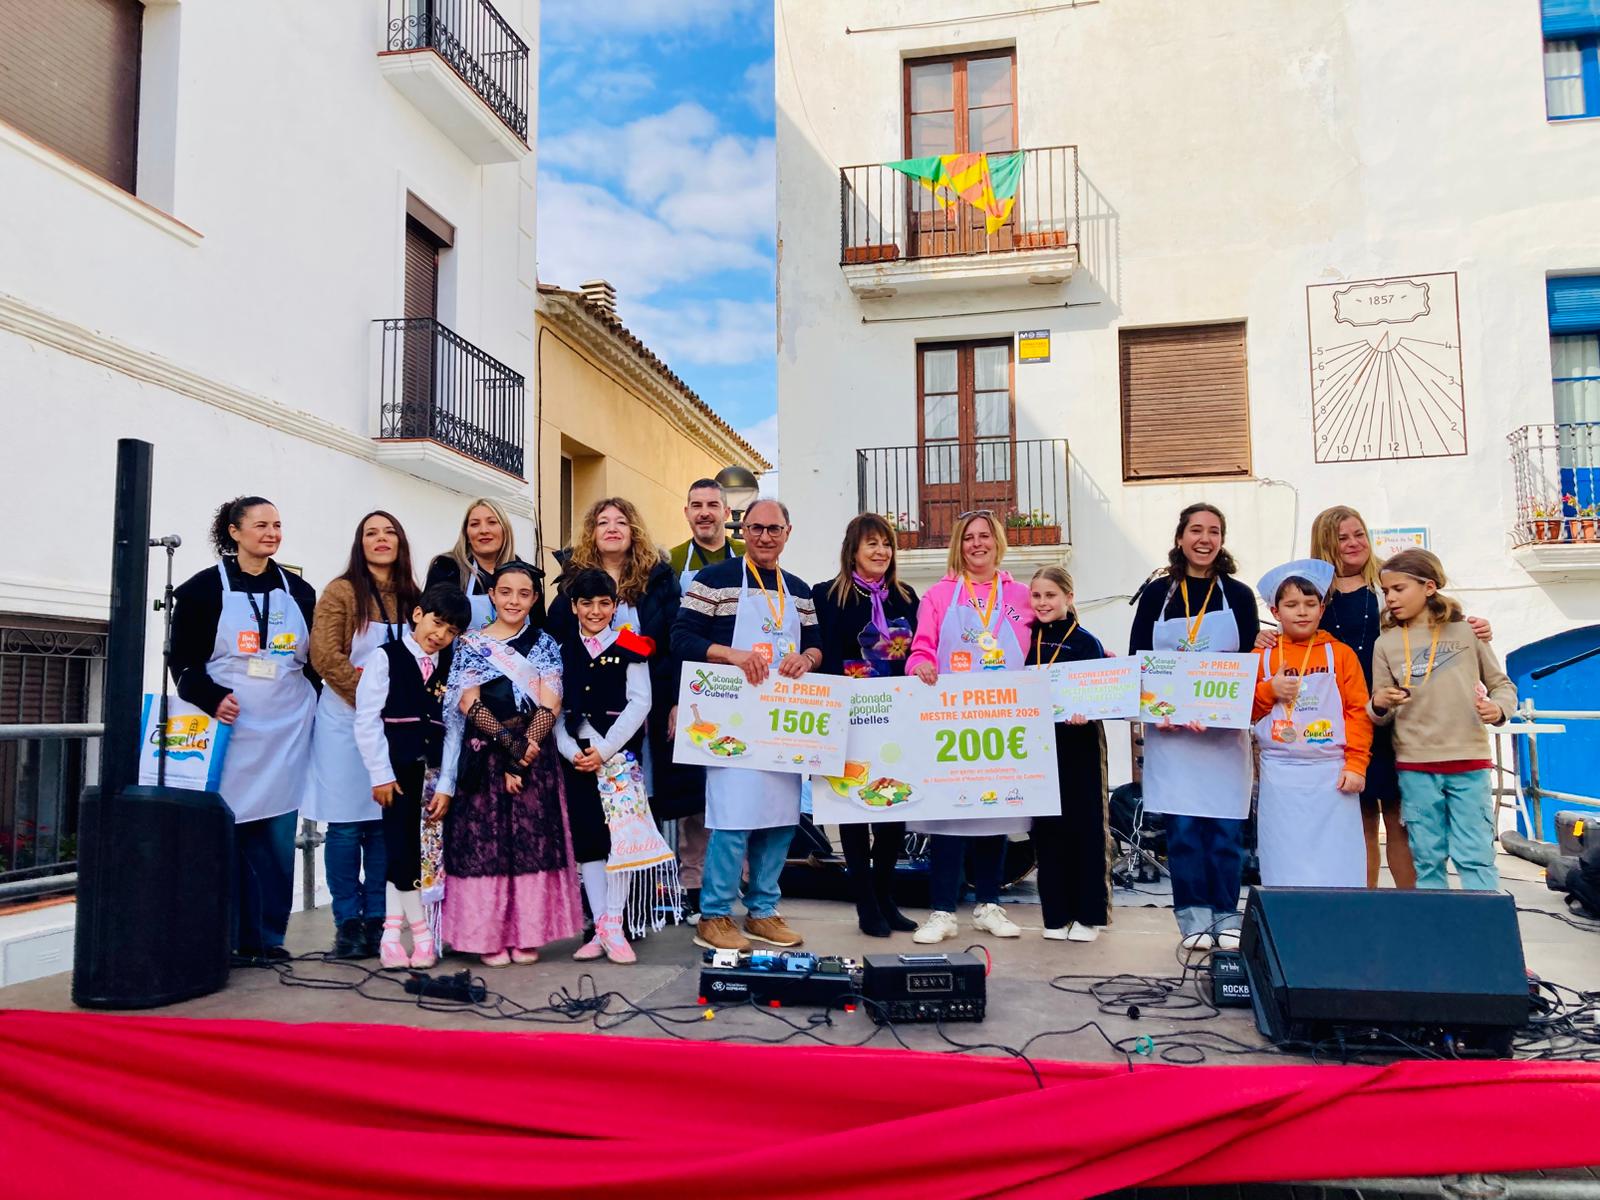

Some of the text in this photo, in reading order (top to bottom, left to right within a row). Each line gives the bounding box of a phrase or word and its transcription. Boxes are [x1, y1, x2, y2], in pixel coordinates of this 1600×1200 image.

[1369, 295, 1394, 305] 1857
[1337, 444, 1348, 454] 10
[1363, 444, 1371, 453] 11
[1388, 443, 1399, 452] 12
[1200, 661, 1240, 670] 3r PREMI
[713, 683, 743, 693] popular
[774, 682, 830, 697] 2n PREMI
[1193, 680, 1240, 699] 100€
[704, 690, 739, 700] Cubelles
[760, 695, 786, 704] MESTRE
[850, 692, 892, 703] atonada
[939, 688, 1018, 707] 1r PREMI
[854, 703, 892, 715] popular
[920, 707, 1040, 721] MESTRE XATONAIRE 2026
[768, 708, 831, 736] 150€
[850, 715, 889, 725] ubelles
[935, 726, 1028, 762] 200€
